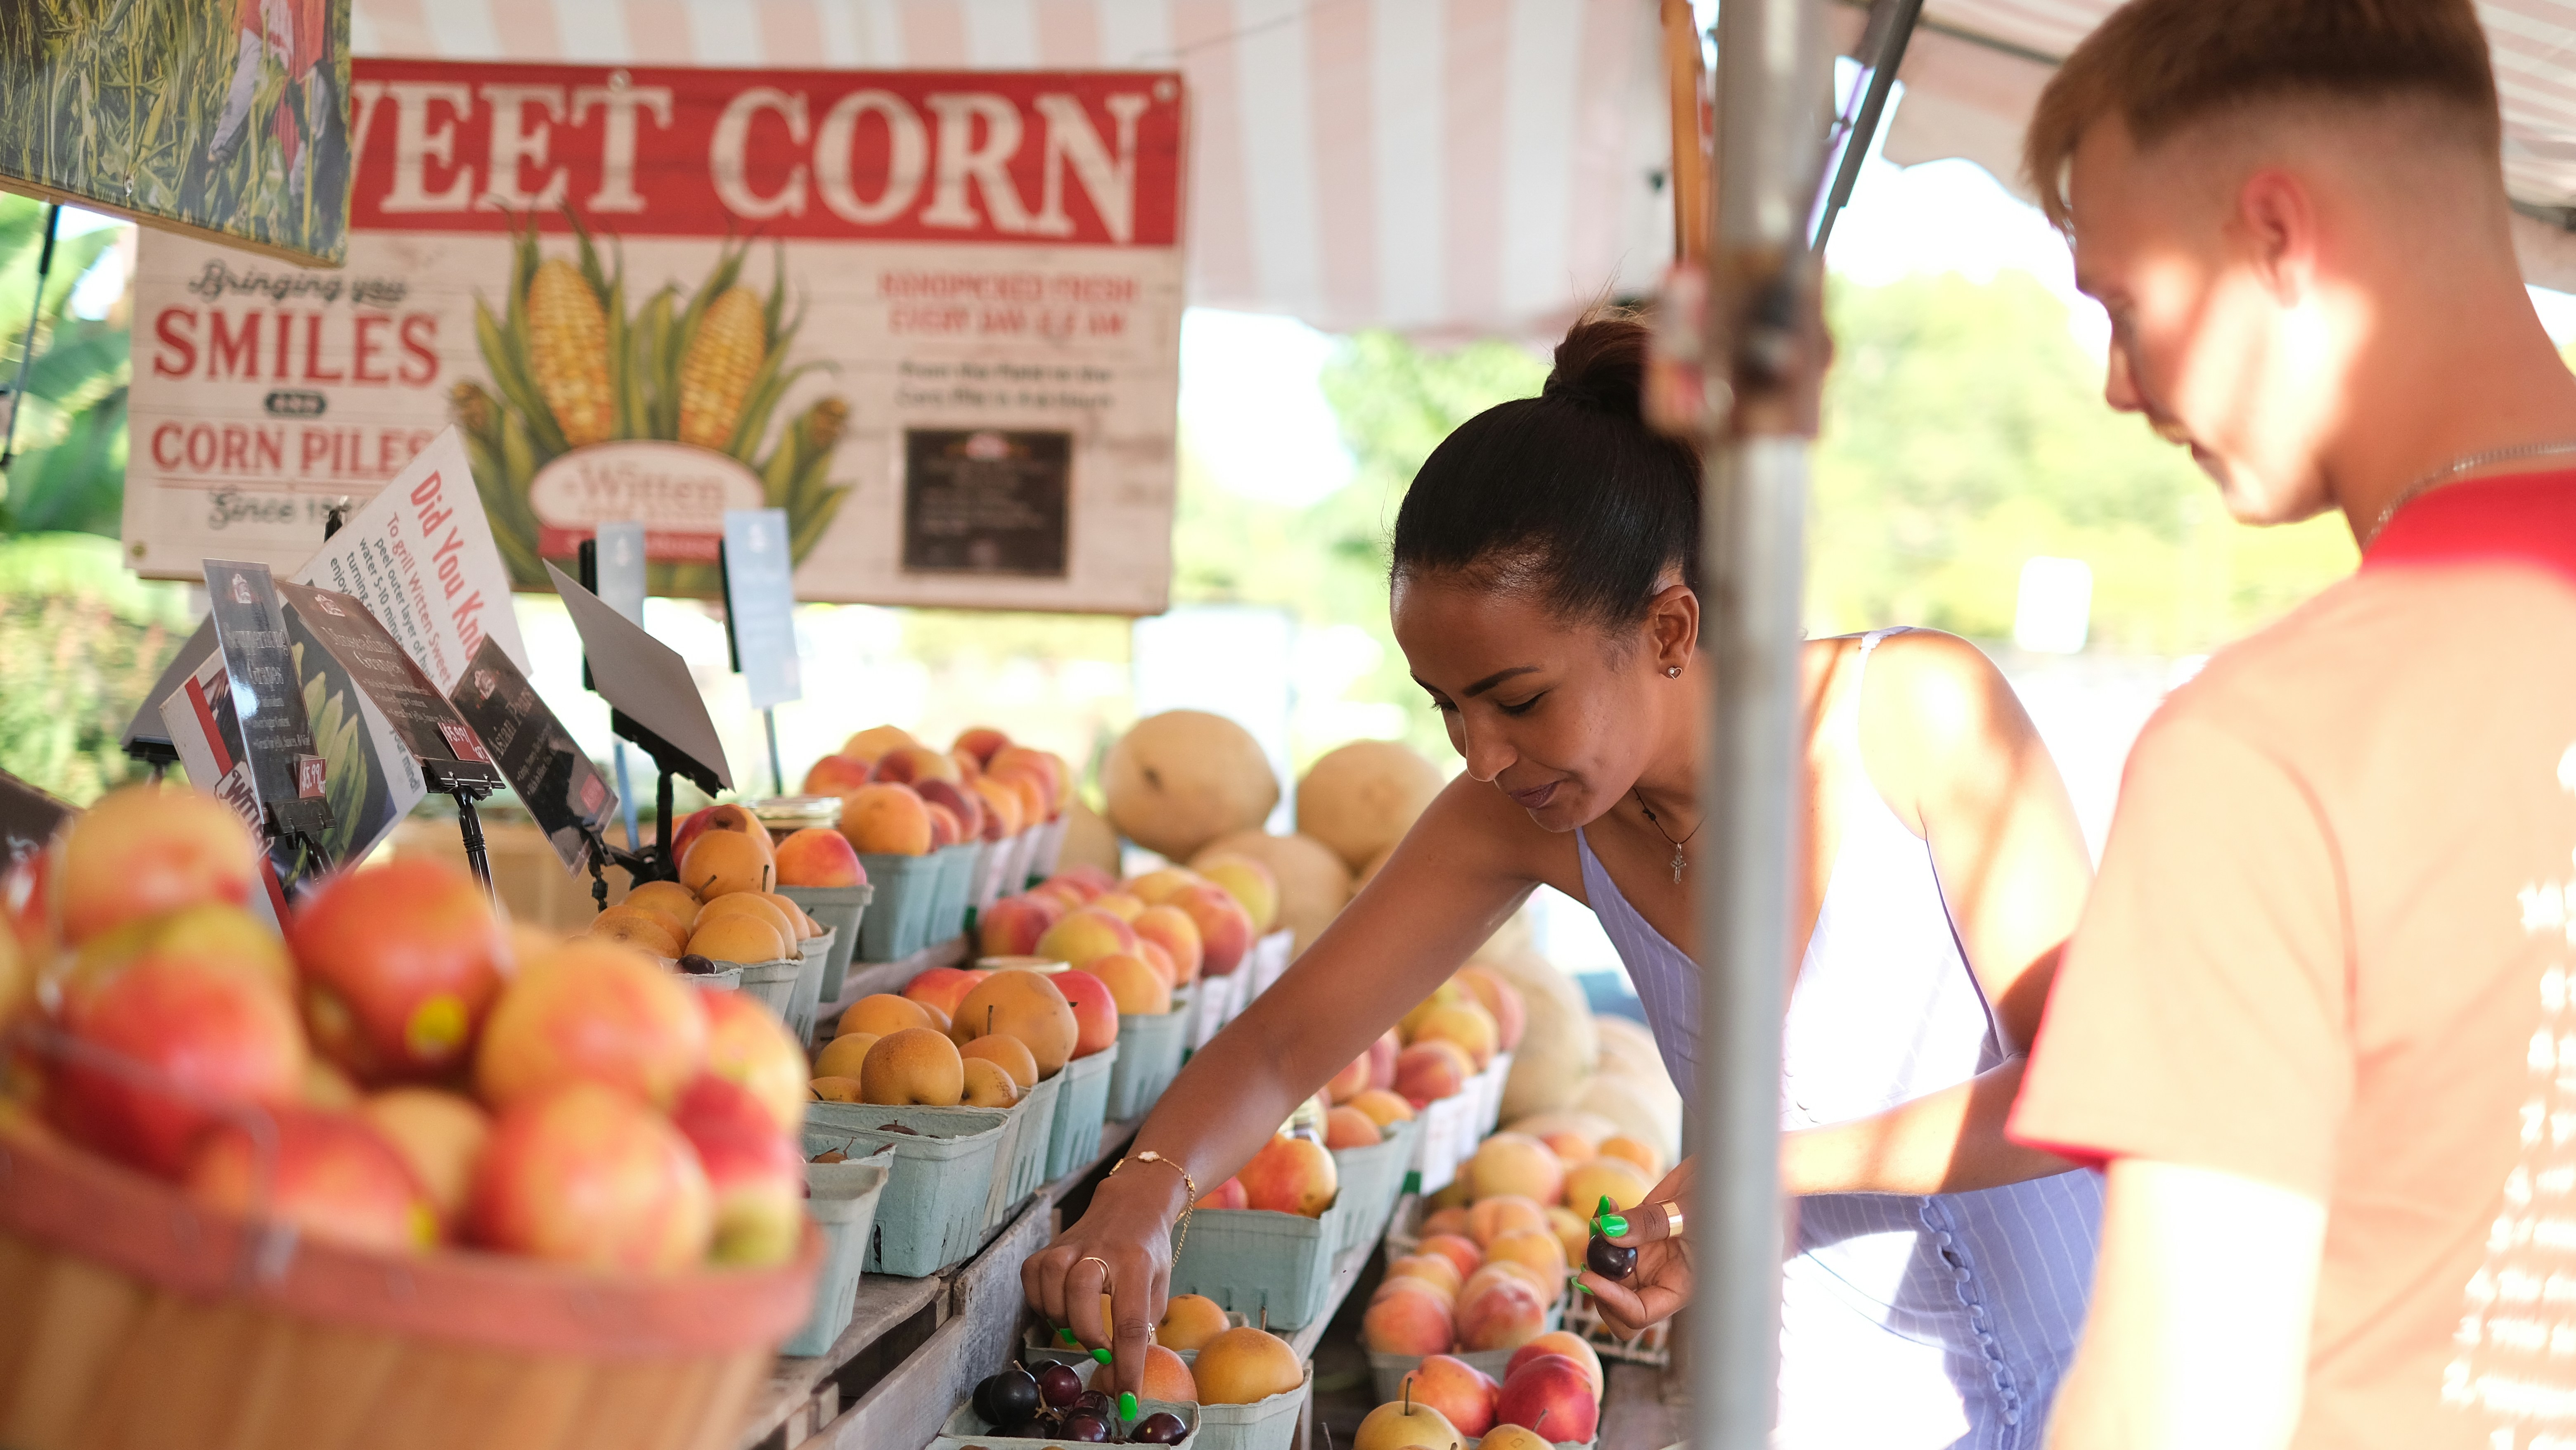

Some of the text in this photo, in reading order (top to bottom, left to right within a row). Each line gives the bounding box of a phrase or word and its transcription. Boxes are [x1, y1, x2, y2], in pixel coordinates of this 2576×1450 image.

[352, 82, 1151, 244] EET CORN
[151, 303, 440, 388] SMILES
[151, 421, 285, 474] CORN
[387, 512, 400, 538] To
[347, 551, 369, 604] turning
[359, 537, 377, 576] water
[374, 576, 389, 605] 5-10
[391, 540, 416, 576] grill
[411, 469, 453, 539] Did
[432, 525, 465, 601] You
[452, 589, 485, 662] Kno
[374, 537, 394, 569] peel
[388, 569, 405, 605] outer
[401, 603, 417, 639] layer
[413, 640, 426, 656] of
[408, 571, 433, 635] Witten
[320, 626, 397, 656] Muscadine
[354, 650, 405, 677] Grapes
[429, 631, 451, 686] Sweet
[488, 687, 535, 761] Asian Pears
